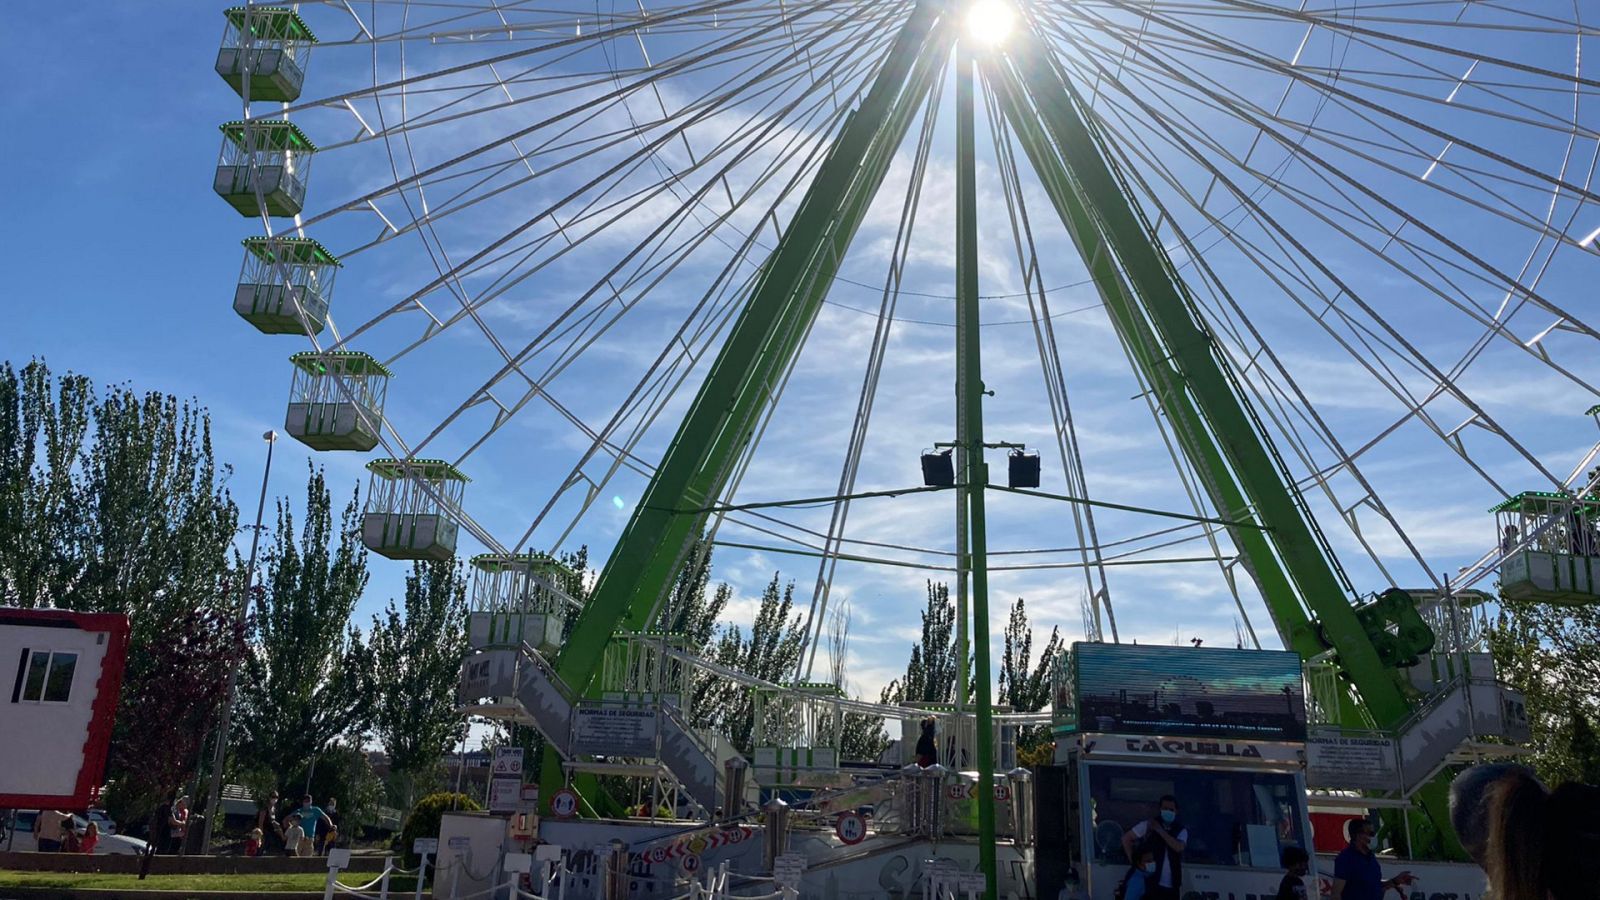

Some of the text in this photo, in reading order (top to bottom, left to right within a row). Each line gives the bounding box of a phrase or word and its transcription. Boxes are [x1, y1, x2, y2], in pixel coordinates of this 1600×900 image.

[579, 709, 607, 717] NORMAS
[618, 710, 655, 718] SEGURIDAD
[1340, 738, 1348, 746] DE
[1350, 739, 1391, 747] SEGURIDAD
[1125, 738, 1262, 759] TAQUILLA
